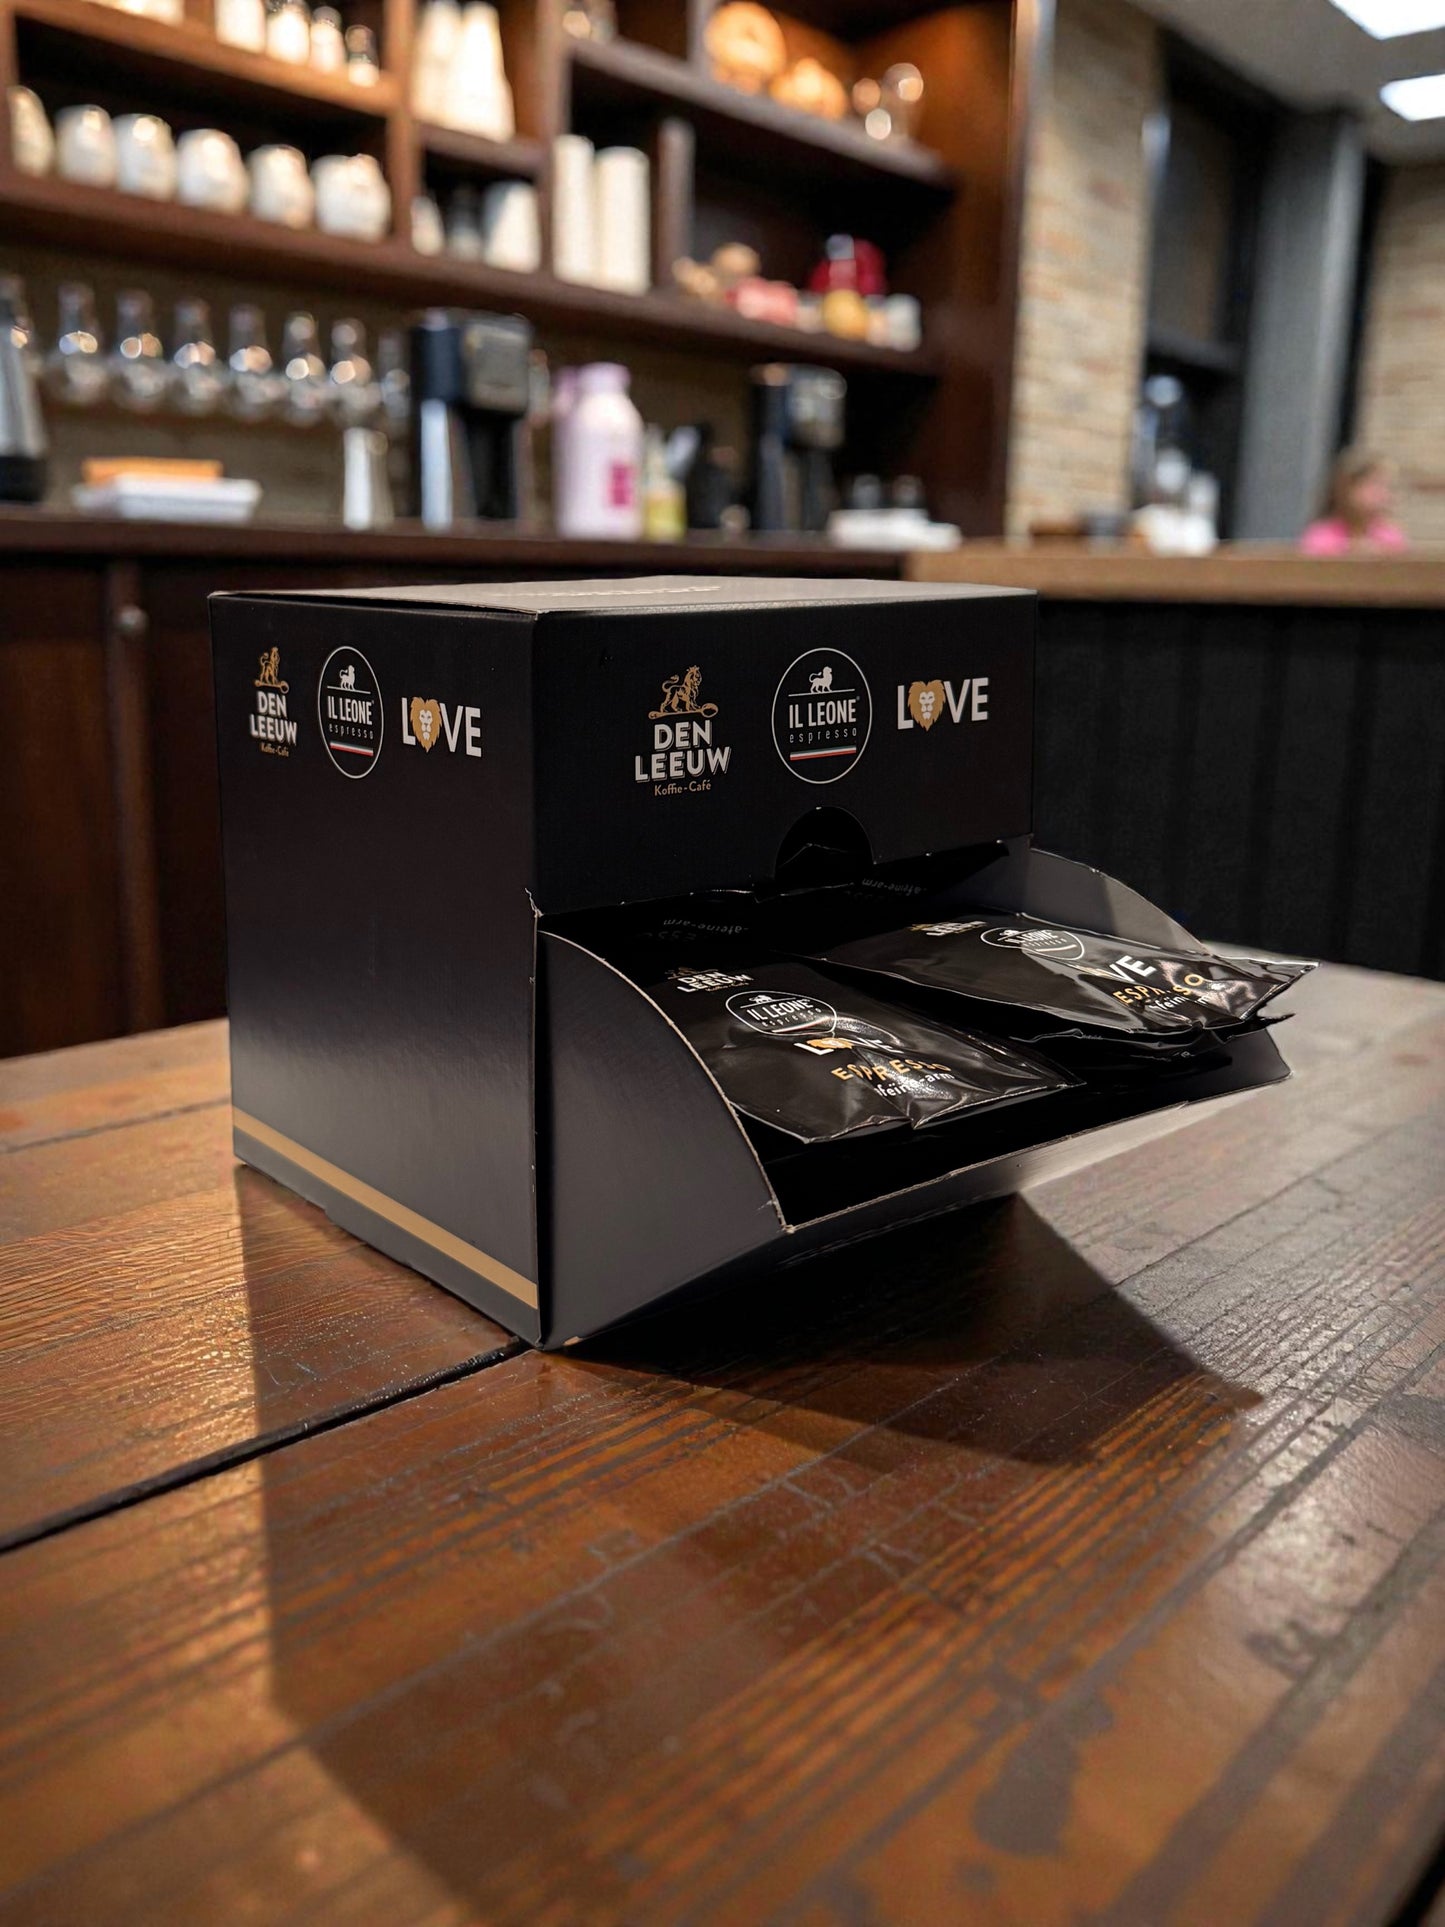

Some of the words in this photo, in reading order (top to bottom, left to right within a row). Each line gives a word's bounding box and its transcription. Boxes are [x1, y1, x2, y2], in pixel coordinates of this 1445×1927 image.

[257, 690, 288, 719] DEN
[327, 695, 338, 719] IL
[339, 697, 373, 726] LEONE
[789, 704, 804, 729] IL
[808, 699, 857, 727] LEONE
[250, 713, 297, 746] LEEUW
[654, 719, 713, 751] DEN
[789, 727, 857, 745] espresso
[634, 746, 731, 783] LEEUW
[676, 973, 755, 993] LEEUW
[746, 1008, 769, 1021] IL
[762, 999, 814, 1018] LEONE
